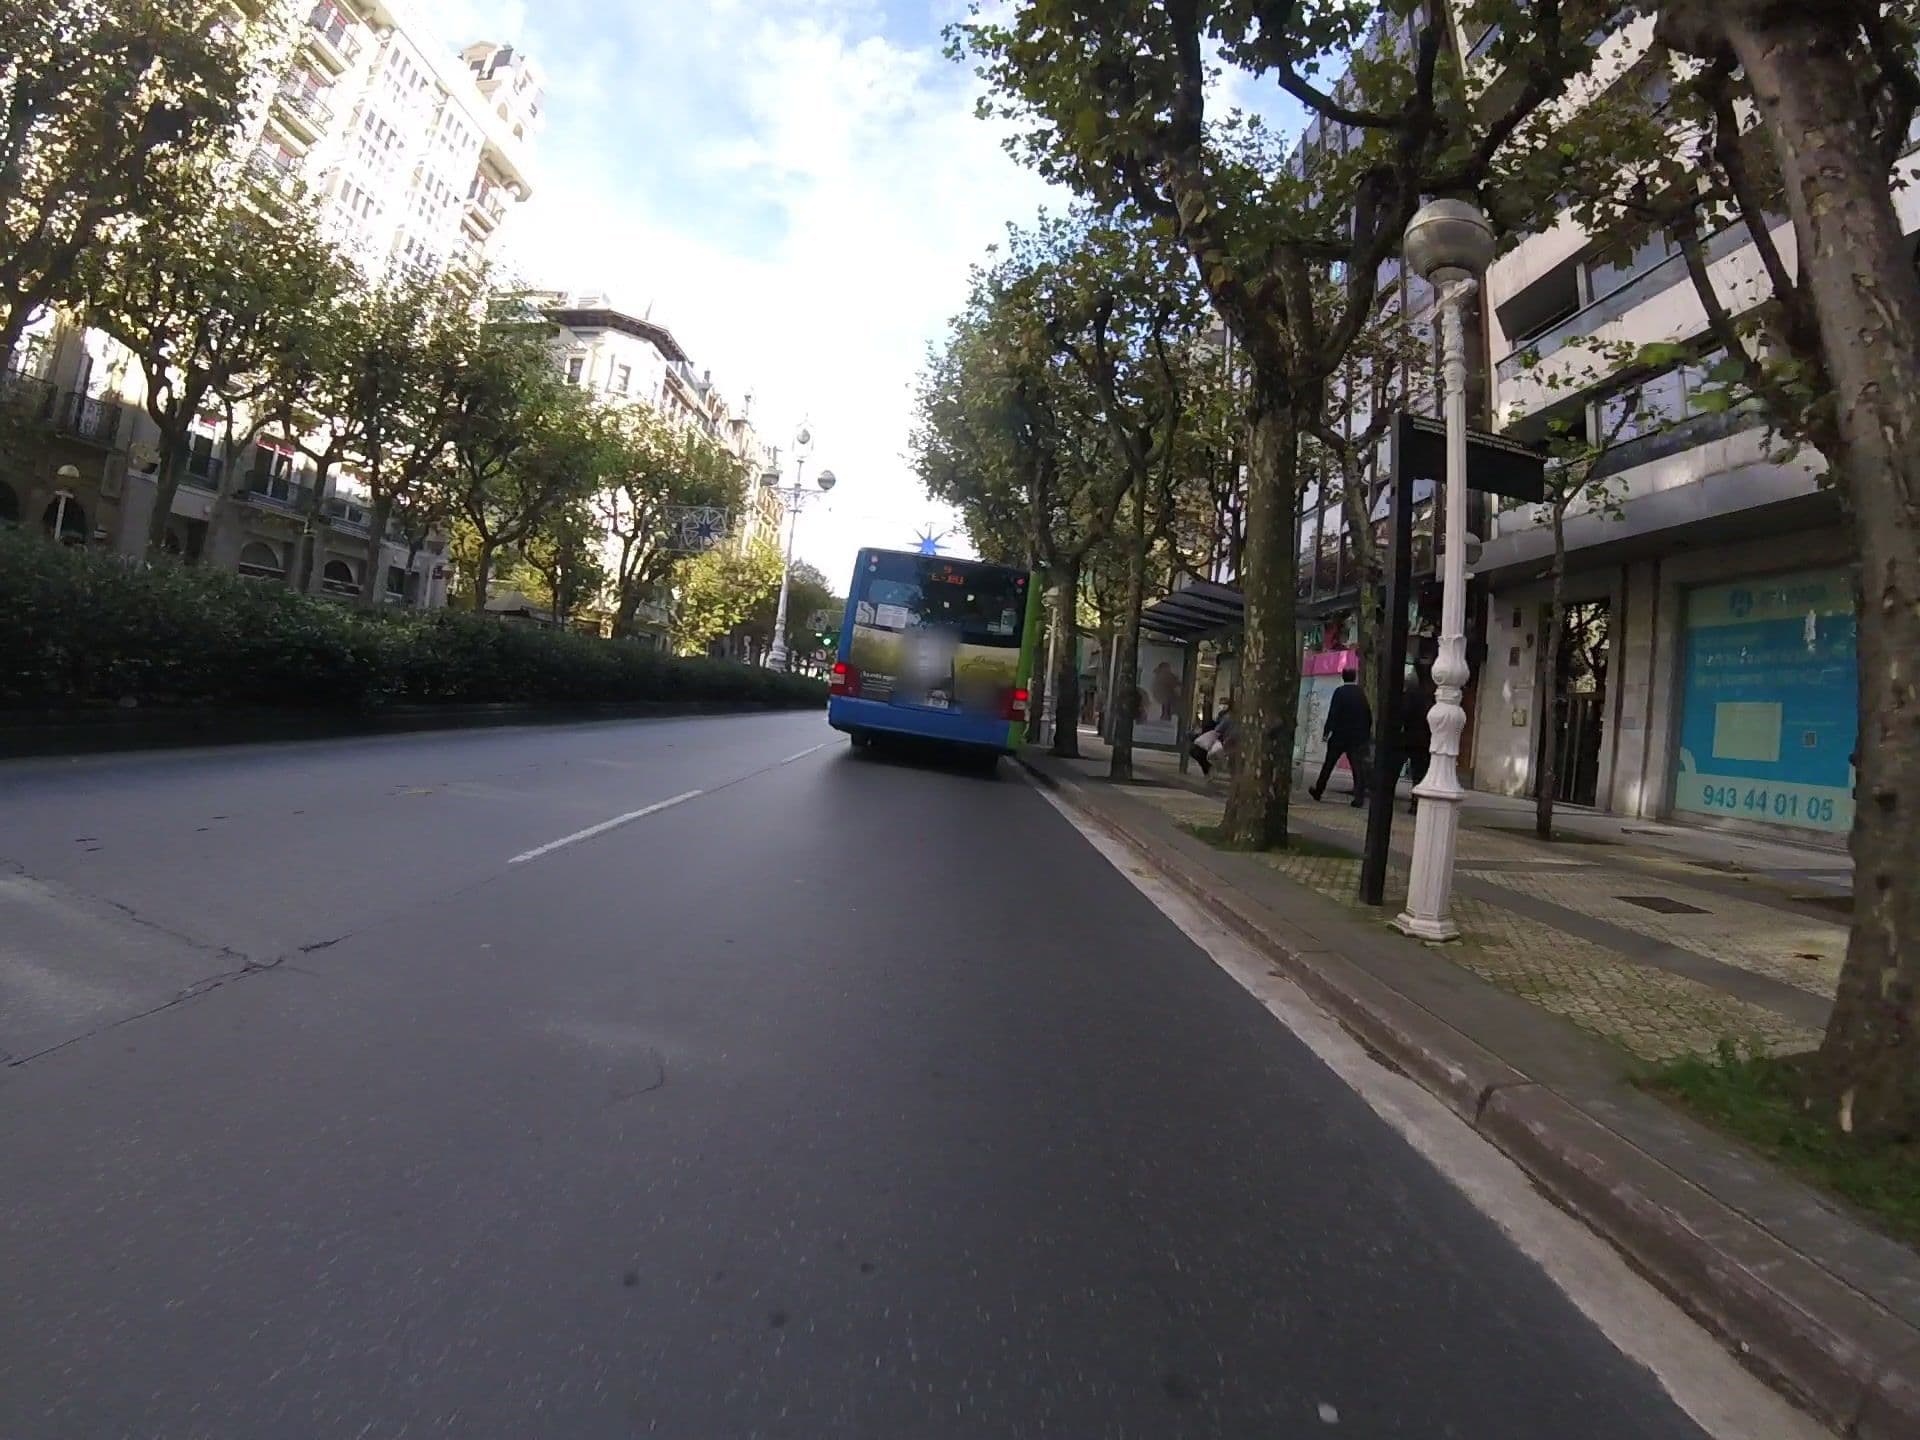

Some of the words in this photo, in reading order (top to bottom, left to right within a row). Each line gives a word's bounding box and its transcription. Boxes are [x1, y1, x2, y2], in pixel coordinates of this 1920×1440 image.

[1703, 785, 1737, 808] 943
[1744, 788, 1767, 811] 44
[1774, 793, 1798, 816] 01
[1807, 796, 1833, 821] 05
